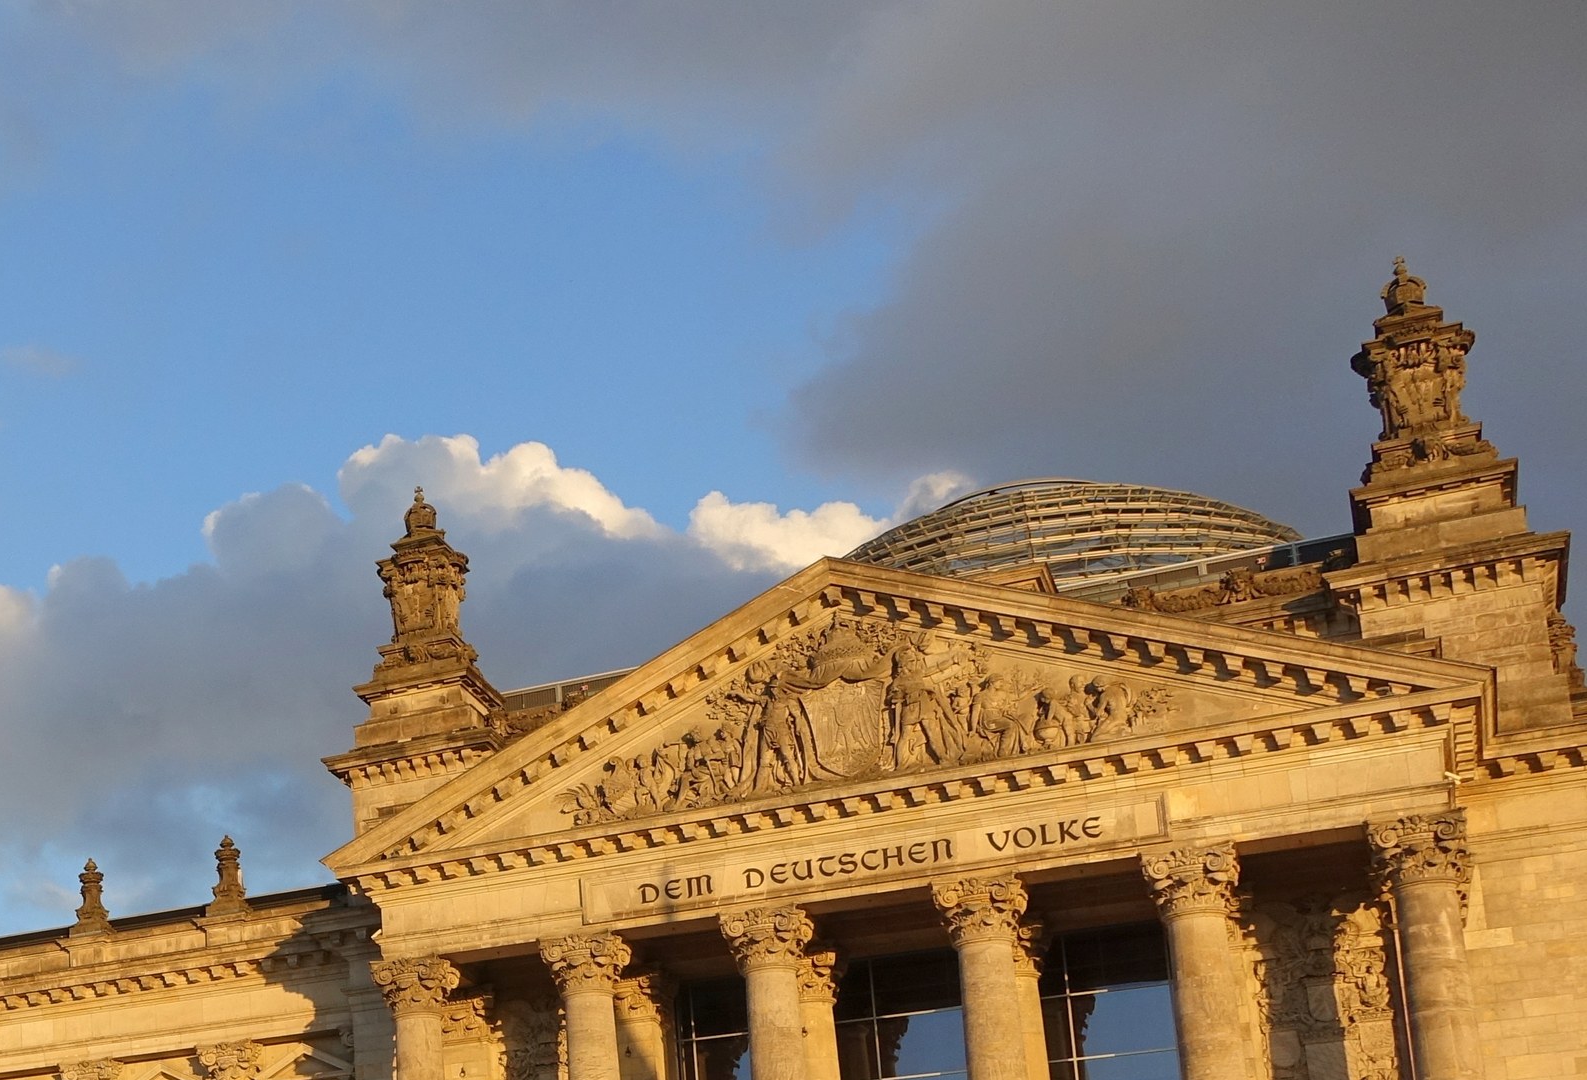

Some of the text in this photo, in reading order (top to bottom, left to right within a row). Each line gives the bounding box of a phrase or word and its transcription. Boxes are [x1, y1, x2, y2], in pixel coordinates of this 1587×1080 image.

[637, 815, 1103, 905] DEM DEUTSCHEN VOLKE
